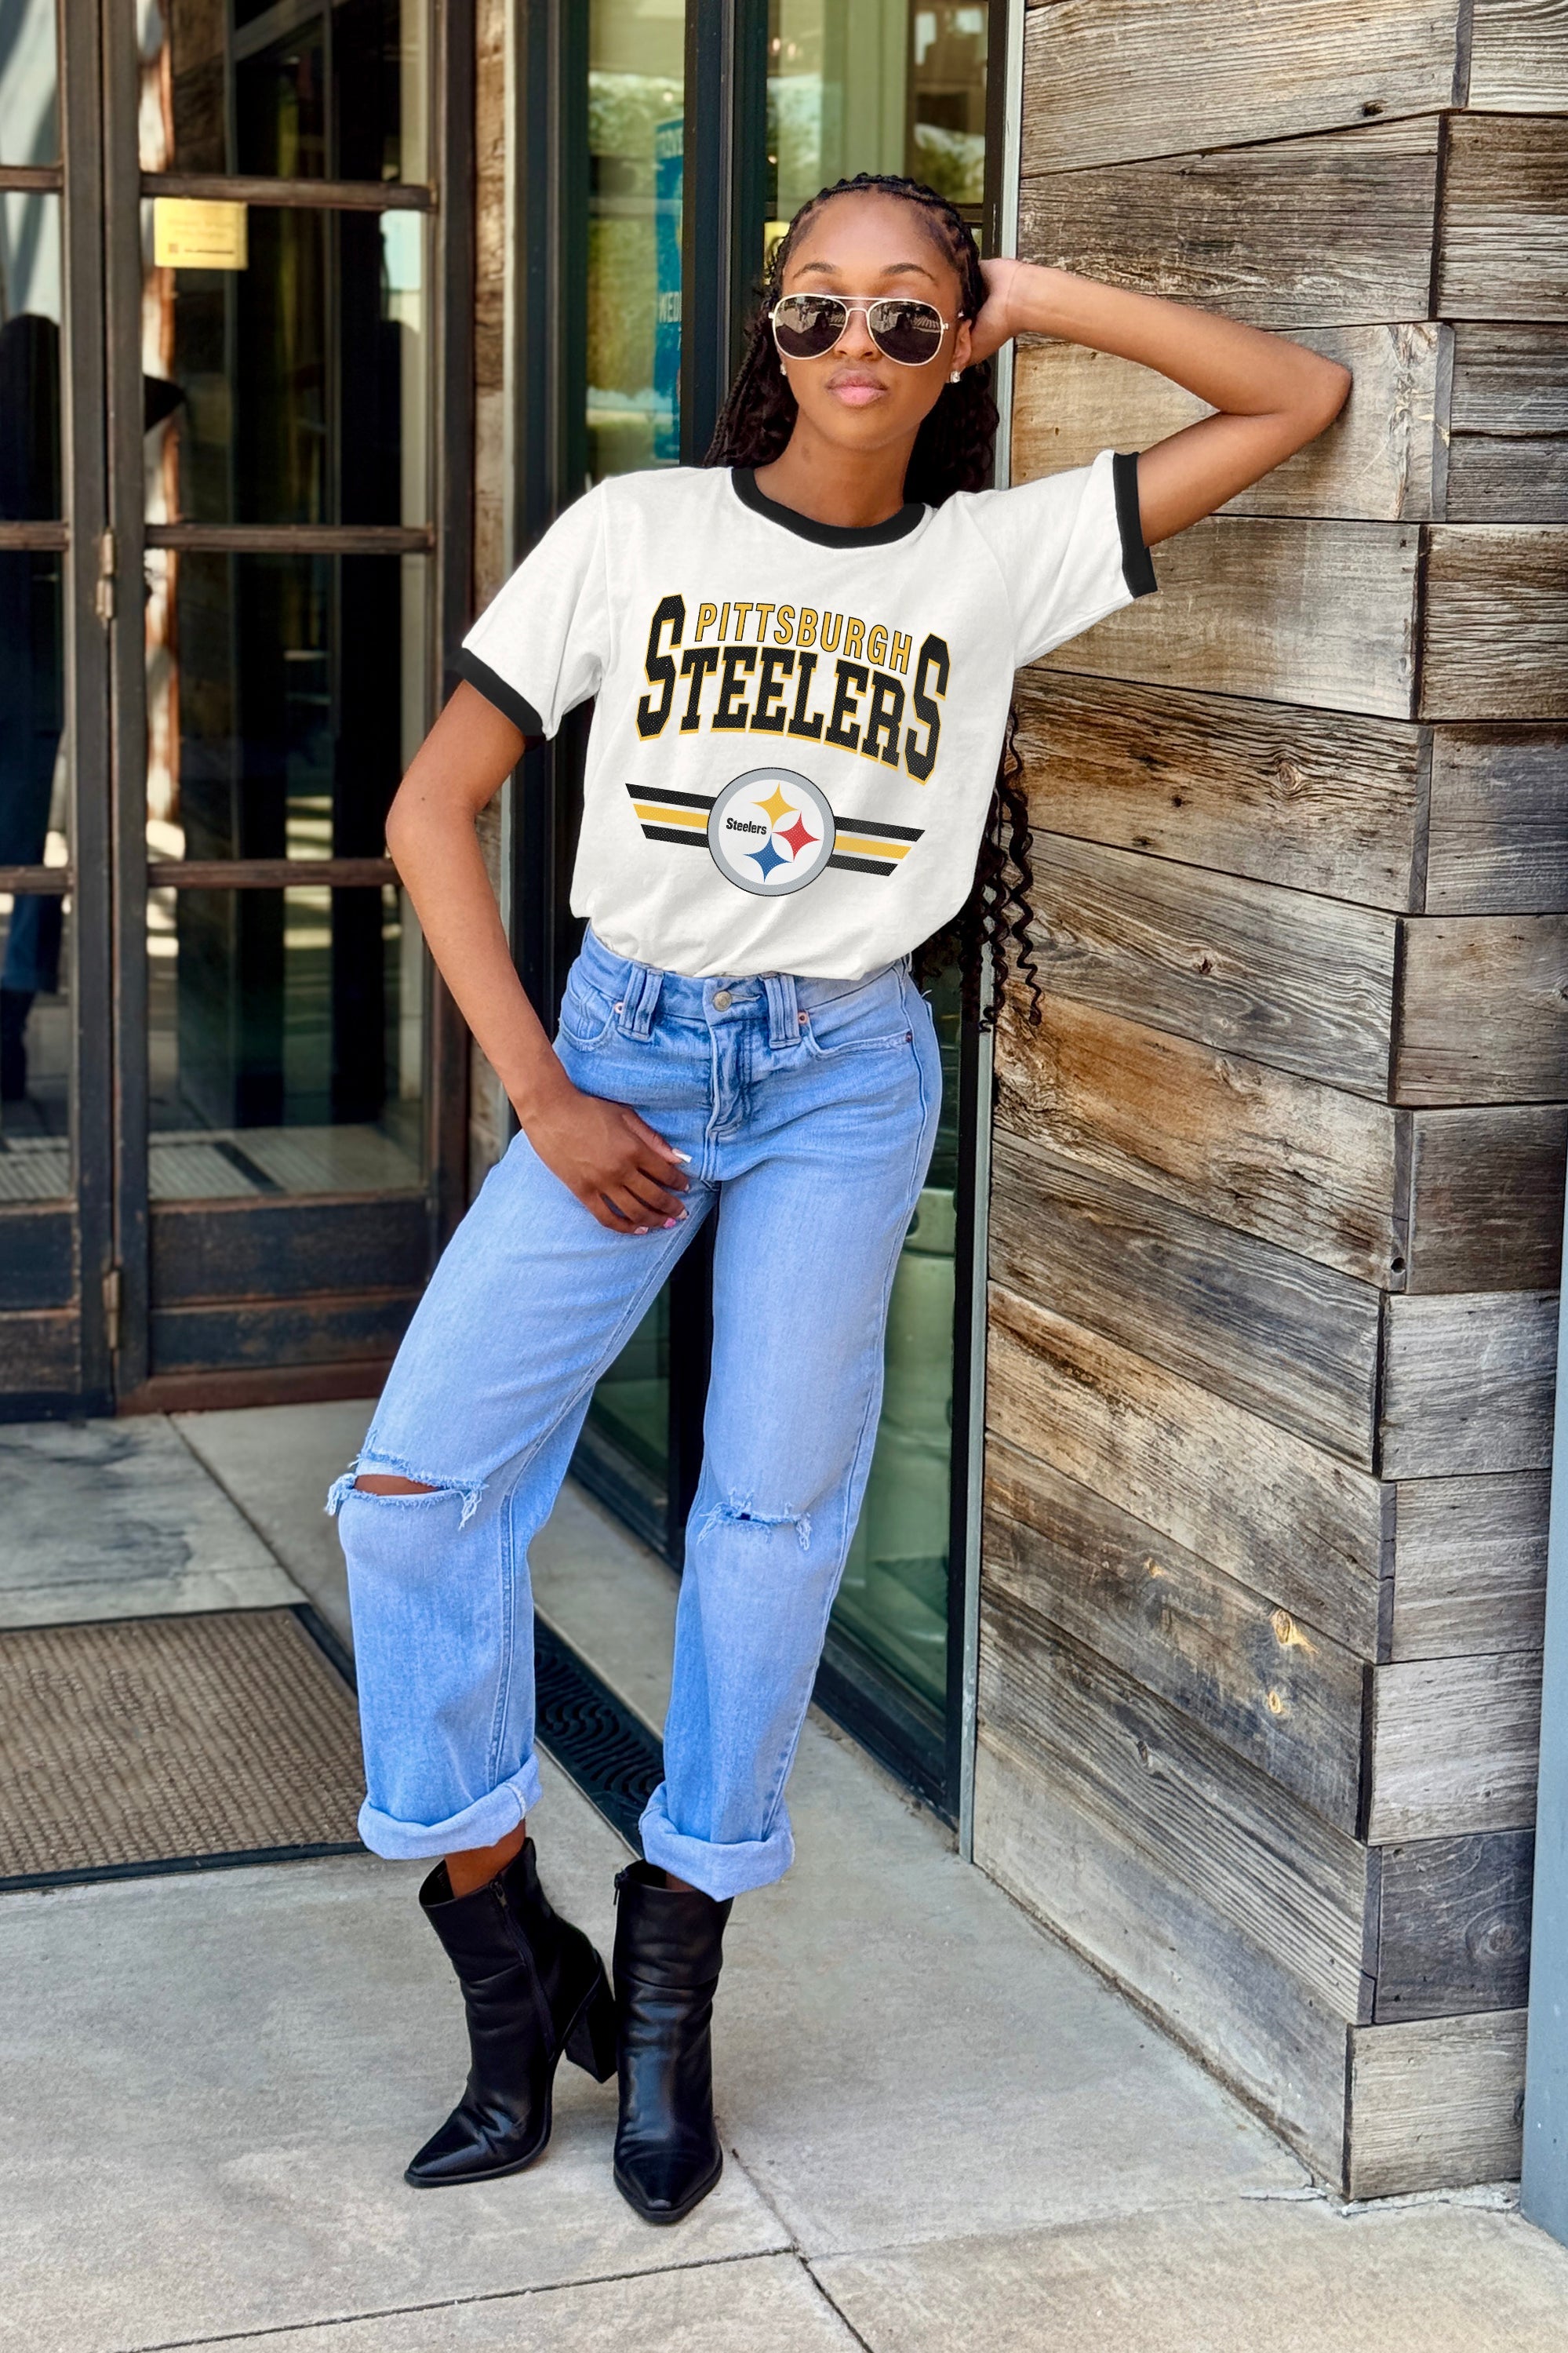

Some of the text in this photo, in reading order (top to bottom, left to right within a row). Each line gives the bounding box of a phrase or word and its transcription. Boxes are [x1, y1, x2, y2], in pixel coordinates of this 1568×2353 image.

[659, 289, 682, 323] WED
[695, 602, 912, 675] PITTSBURGH
[636, 594, 950, 786] STEELERS
[726, 818, 766, 835] Steelers
